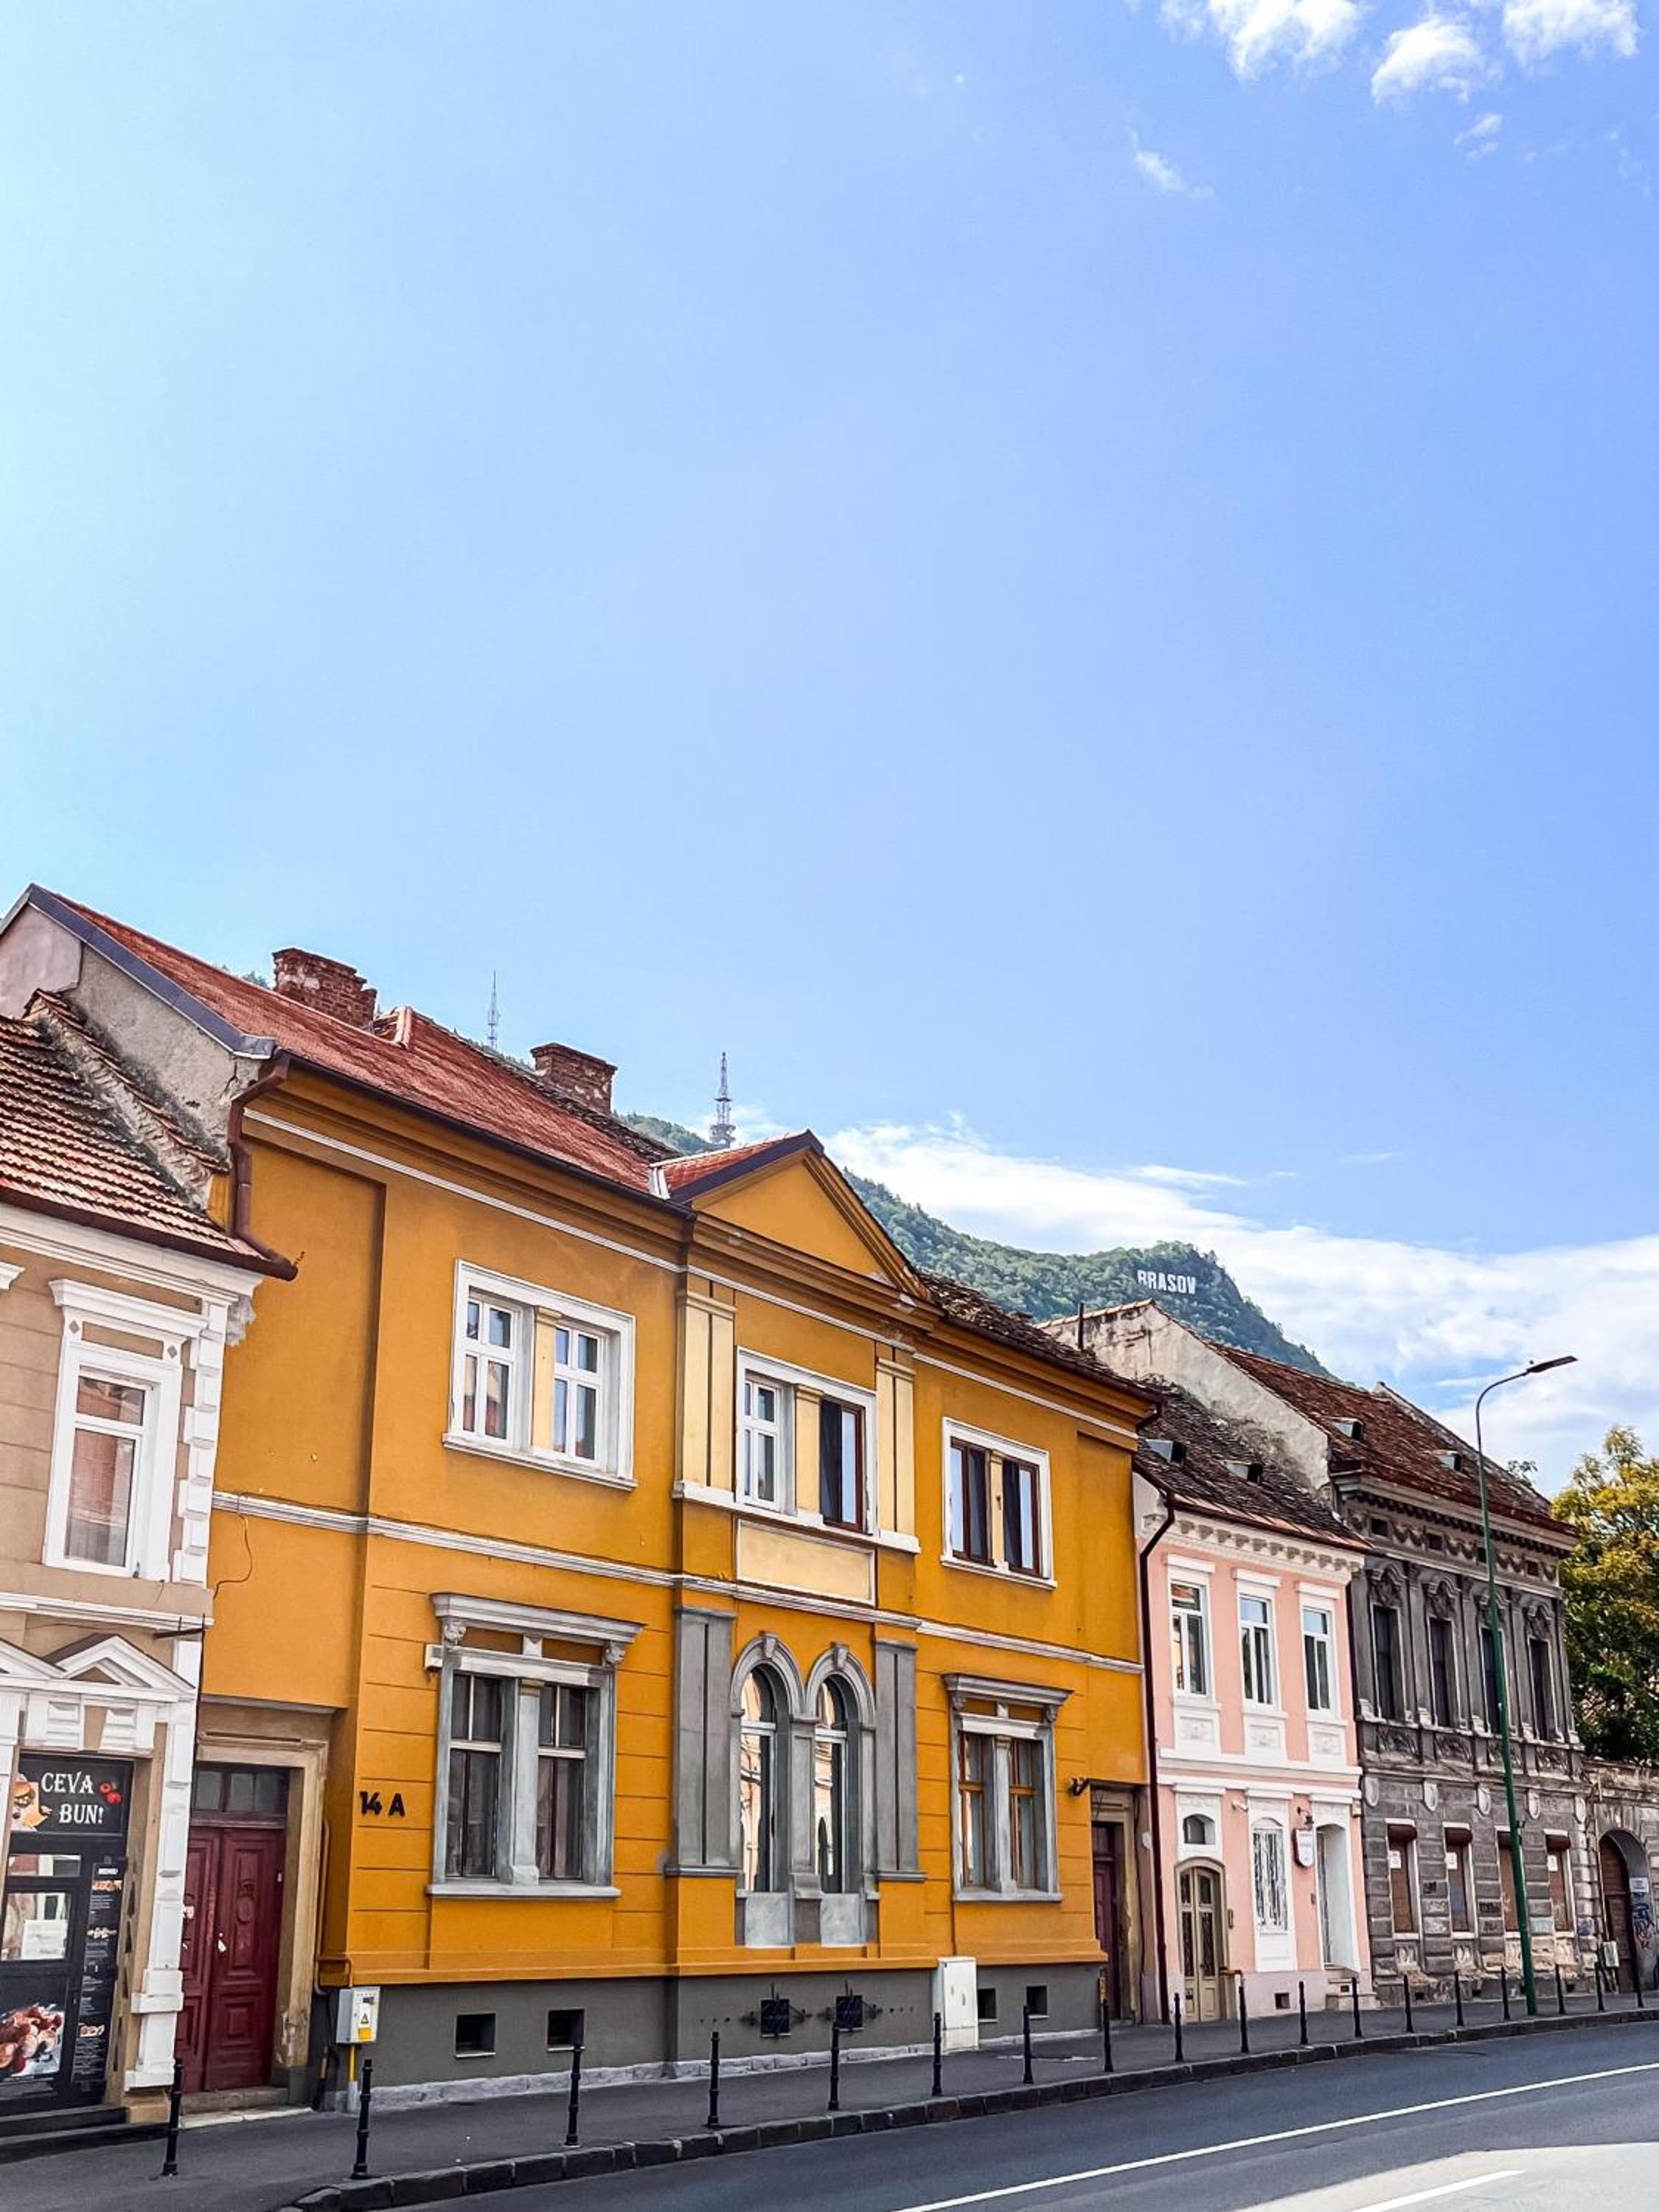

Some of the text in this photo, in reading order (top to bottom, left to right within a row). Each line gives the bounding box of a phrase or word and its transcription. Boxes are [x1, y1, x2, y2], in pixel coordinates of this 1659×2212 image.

[1137, 1270, 1196, 1295] BRASOV
[41, 1772, 94, 1794] CEVA
[59, 1804, 104, 1824] BUN!
[389, 1792, 405, 1817] A
